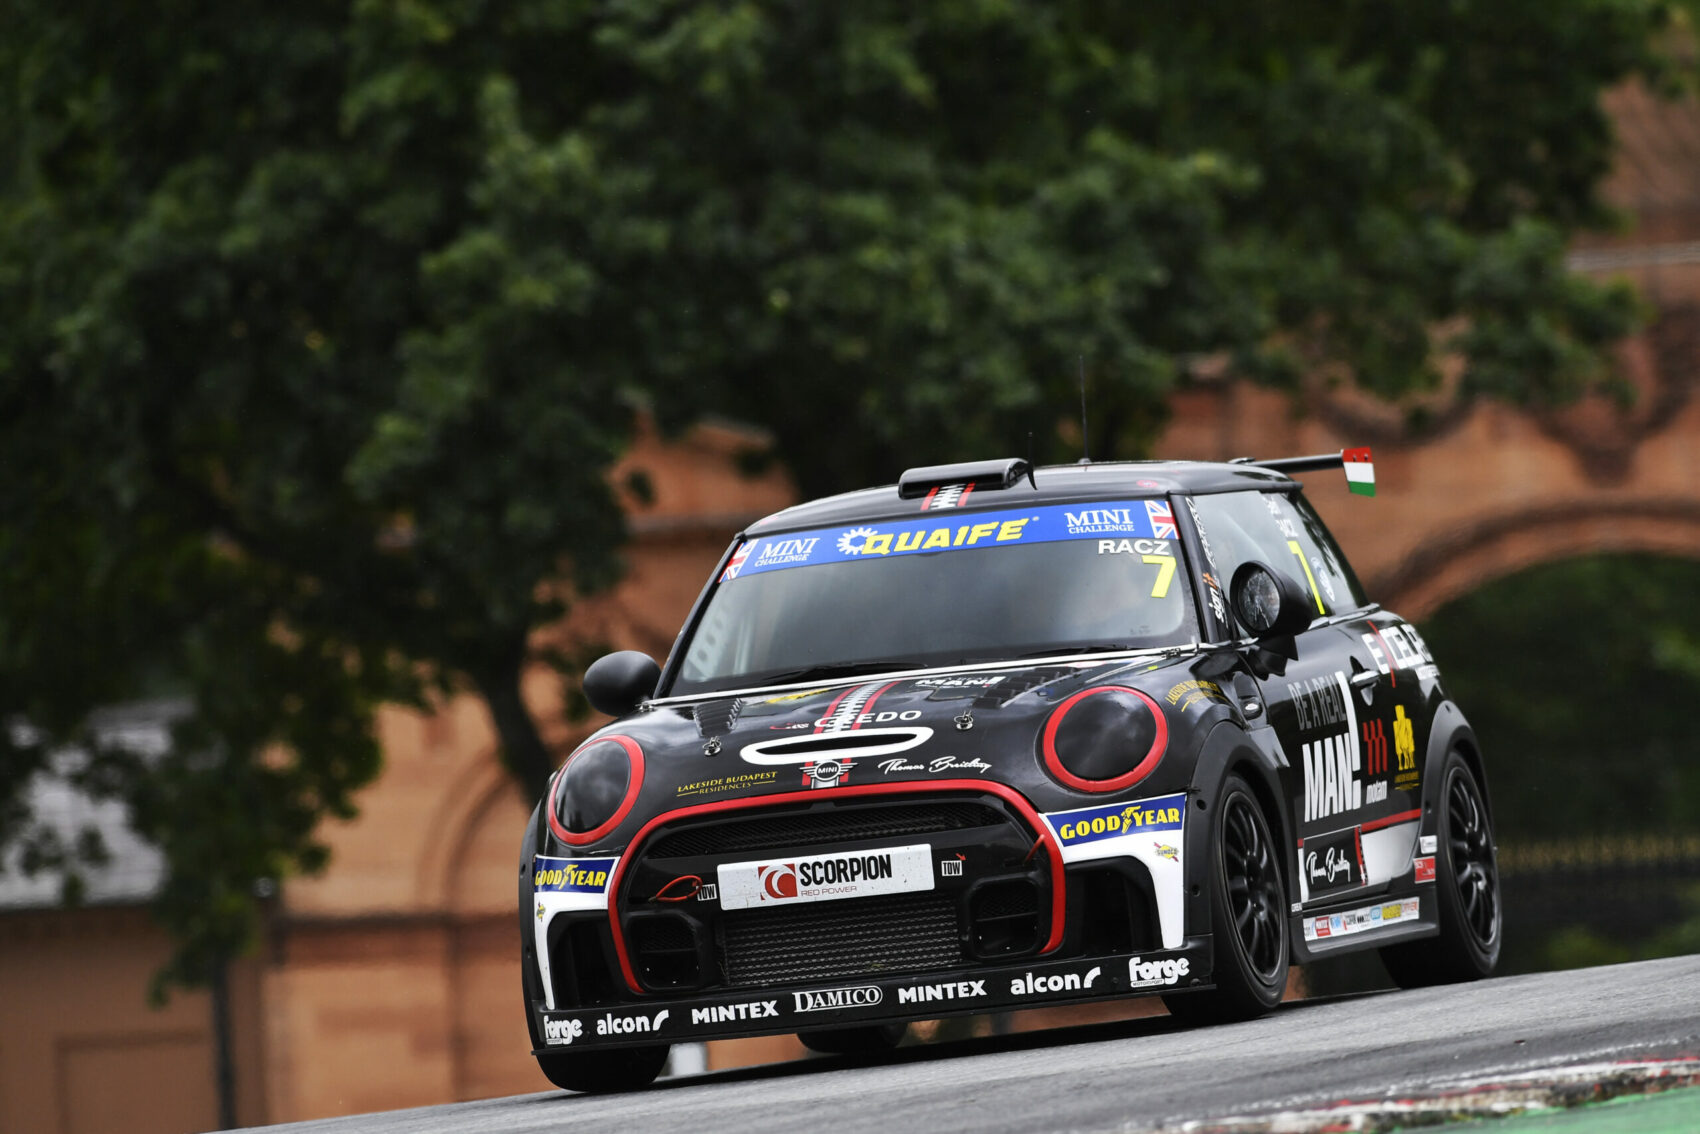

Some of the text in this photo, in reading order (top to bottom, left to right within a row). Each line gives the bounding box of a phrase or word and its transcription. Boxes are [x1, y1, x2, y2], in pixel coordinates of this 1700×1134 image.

[1064, 509, 1134, 528] MINI
[1068, 524, 1135, 534] CHALLENGE
[861, 518, 1030, 555] QUAIFE
[1098, 540, 1170, 555] RACZ
[758, 538, 820, 560] MINI
[755, 554, 810, 568] CHALLENGE
[1142, 555, 1177, 598] 7
[1288, 675, 1347, 730] BE A REAL
[1302, 671, 1361, 823] MAN!
[817, 766, 838, 775] MINI
[878, 758, 925, 775] Thomas
[677, 771, 778, 792] LAKESIDE BUDAPEST
[699, 782, 752, 795] RESIDENCES
[799, 854, 893, 887] SCORPION
[943, 860, 961, 876] TOW
[801, 885, 857, 897] RED POWER
[1129, 957, 1190, 985] forge
[898, 980, 987, 1004] MINTEX
[1011, 971, 1081, 996] alcon
[793, 986, 882, 1012] DAMICO
[691, 1000, 779, 1025] MINTEX
[544, 1015, 583, 1045] forge
[596, 1013, 650, 1036] alcon
